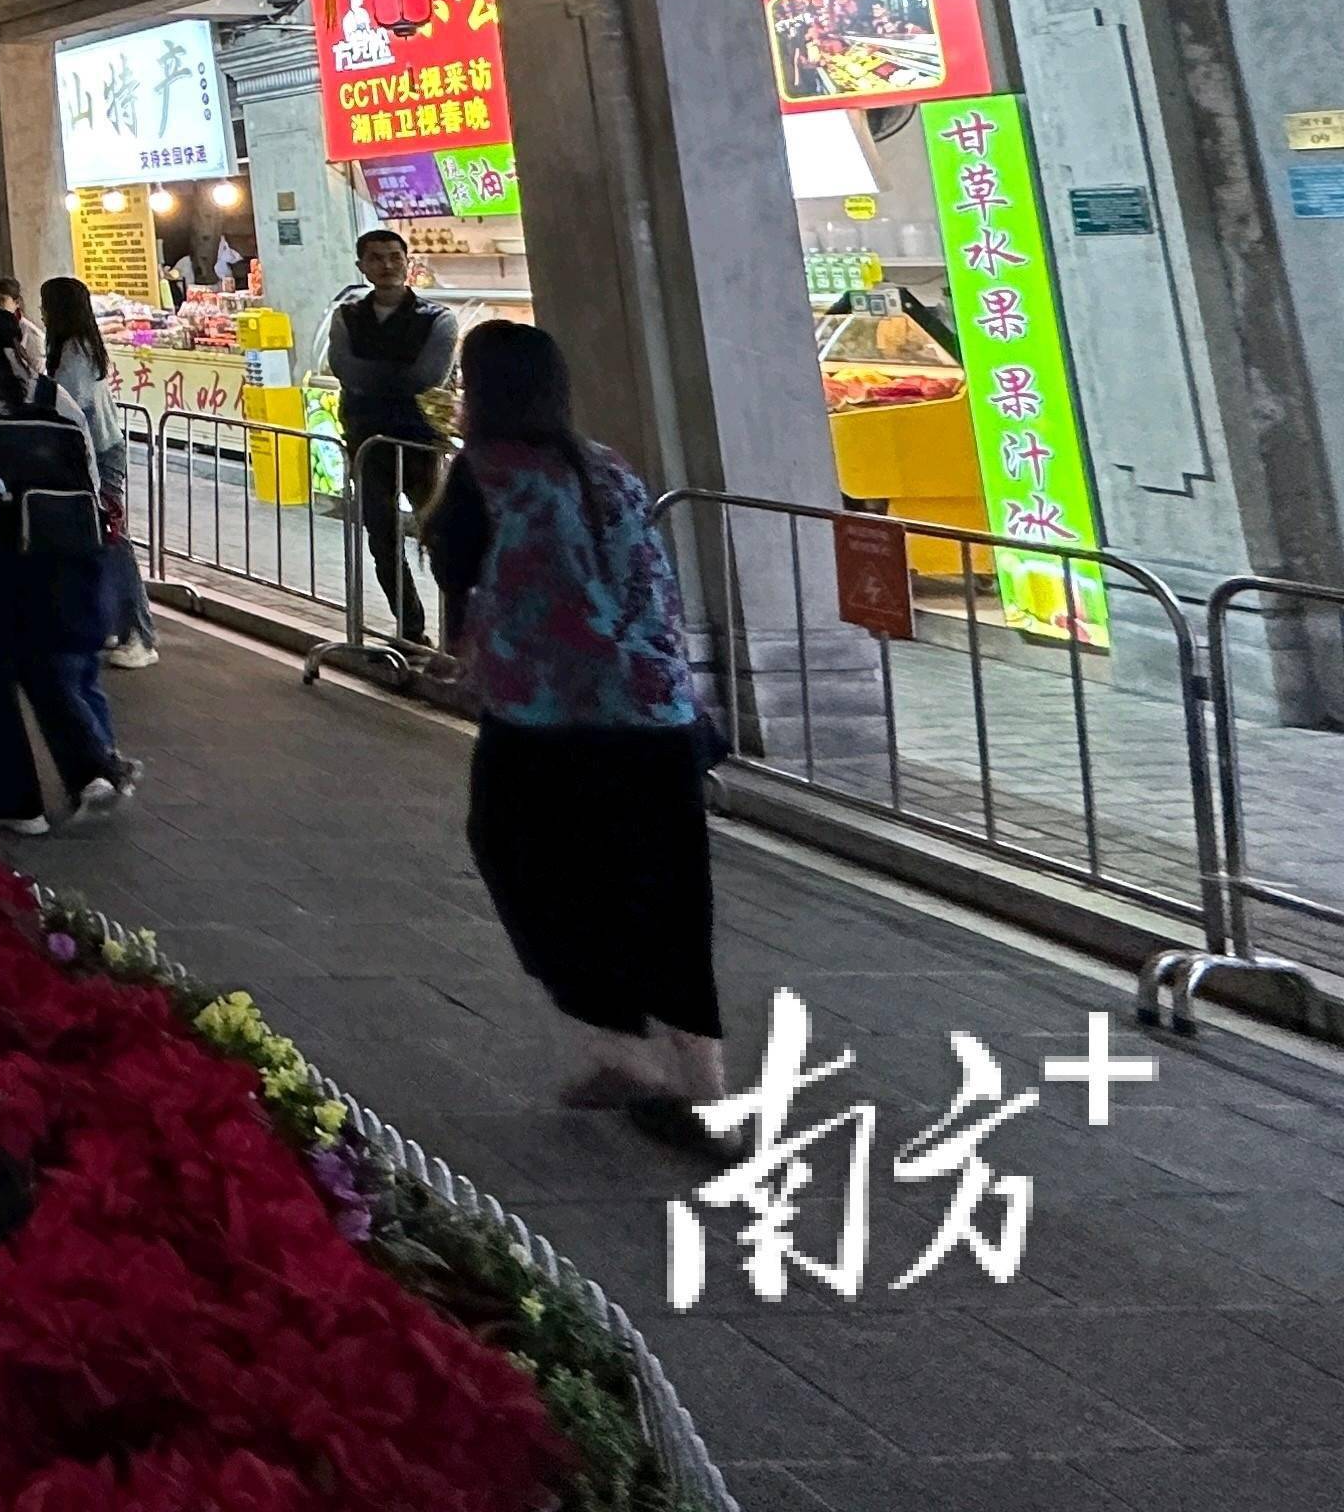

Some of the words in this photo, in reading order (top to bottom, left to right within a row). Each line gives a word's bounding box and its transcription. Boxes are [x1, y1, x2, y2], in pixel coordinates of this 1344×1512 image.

[350, 95, 492, 144] 湖南卫视春晚
[940, 111, 1029, 342] 甘草水果
[990, 366, 1079, 544] 果汁冰
